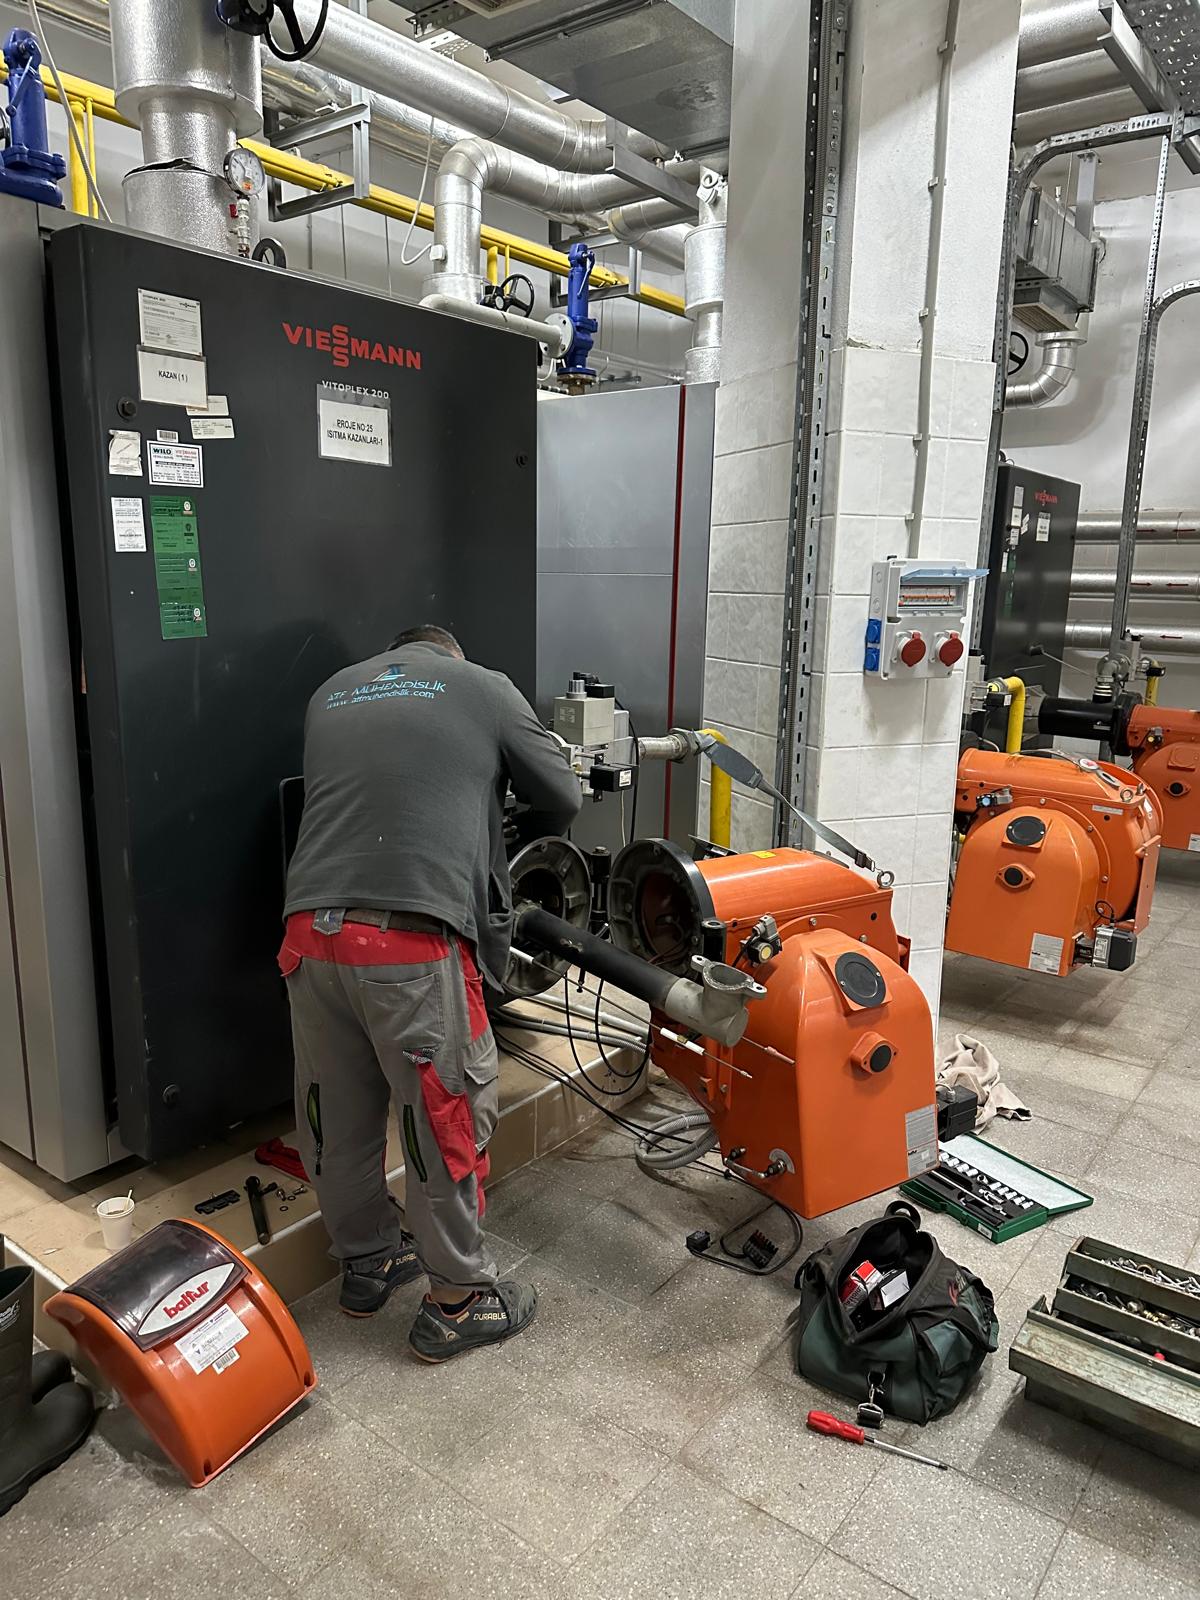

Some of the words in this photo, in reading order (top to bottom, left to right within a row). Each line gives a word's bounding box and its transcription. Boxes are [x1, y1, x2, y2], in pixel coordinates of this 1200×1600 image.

[282, 323, 422, 370] VIESSMANN
[158, 370, 178, 380] KAZAN
[321, 380, 370, 396] VITOPLEX
[371, 389, 390, 399] 200
[336, 419, 356, 430] PROJE
[395, 1253, 417, 1265] DURABL
[473, 1311, 507, 1321] DURABLE
